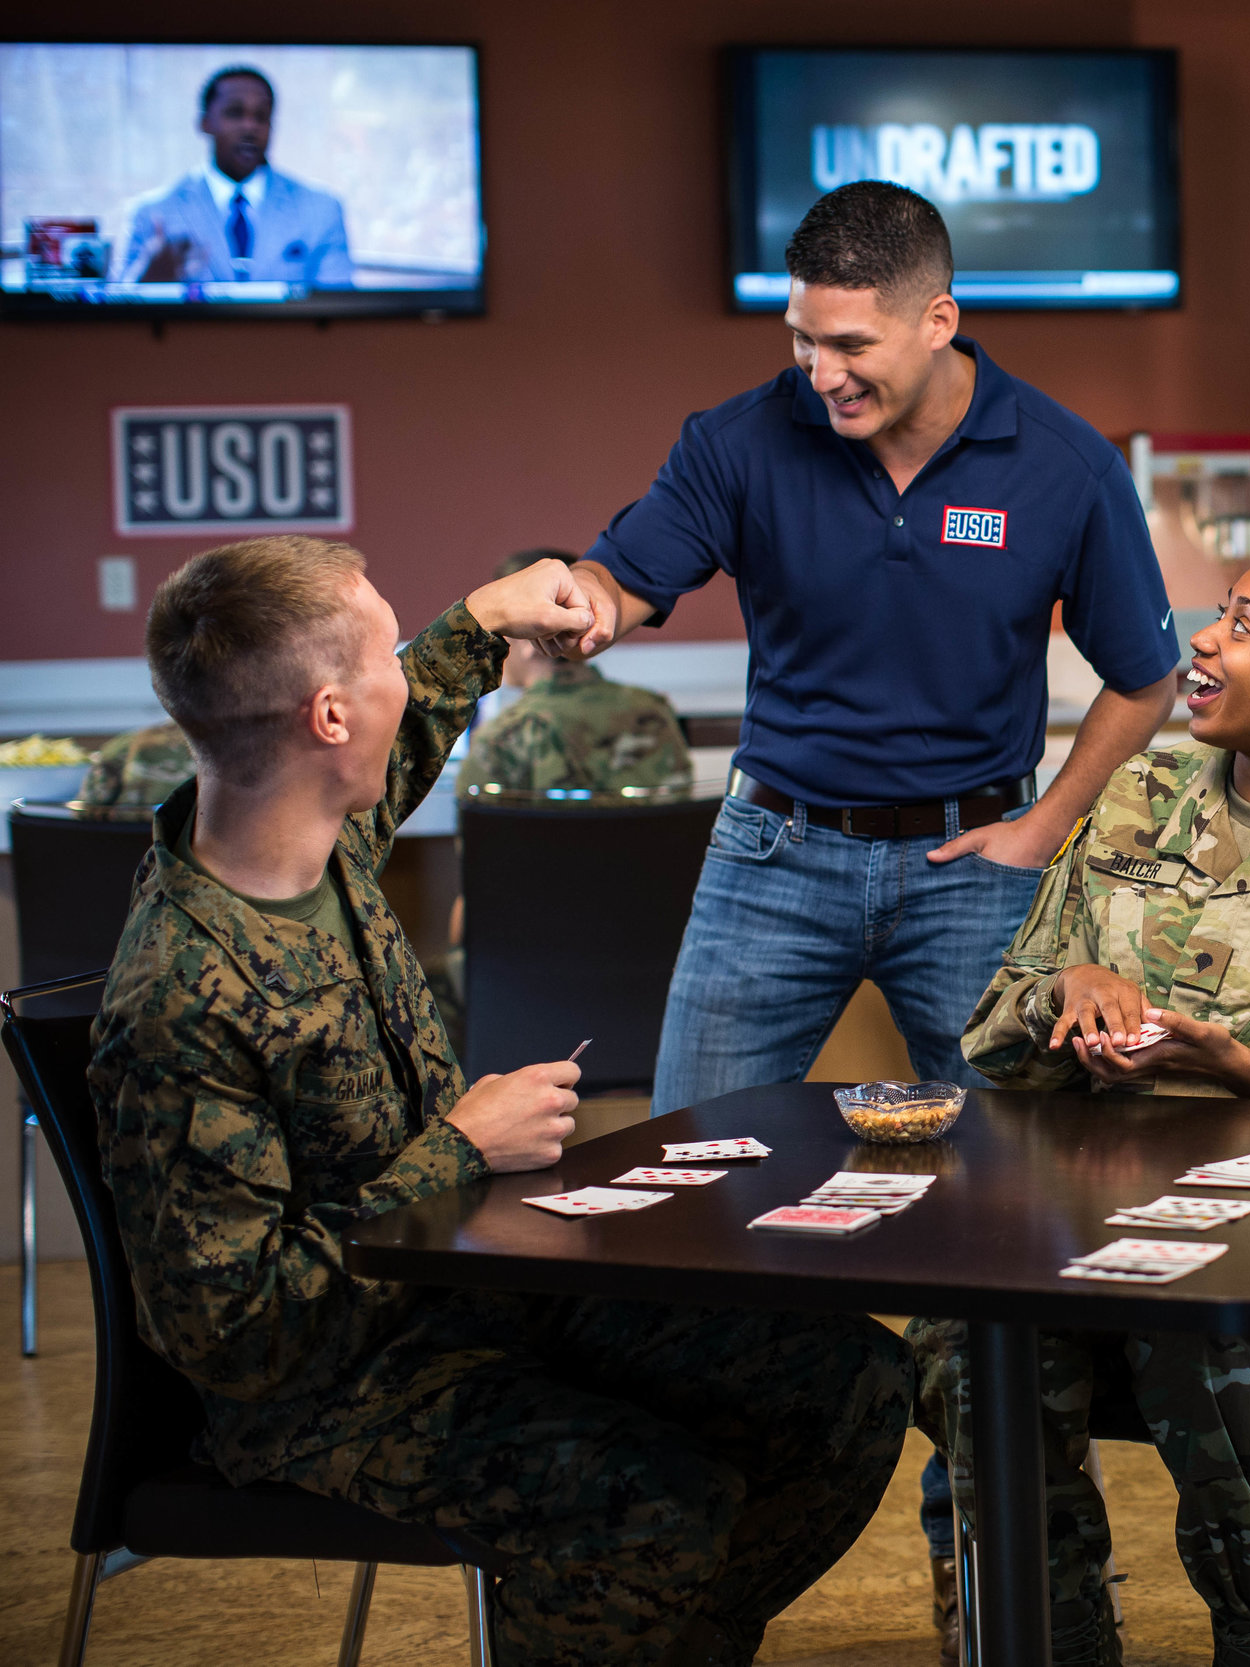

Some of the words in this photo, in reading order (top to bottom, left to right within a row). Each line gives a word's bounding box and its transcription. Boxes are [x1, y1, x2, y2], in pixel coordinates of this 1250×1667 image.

[811, 123, 1099, 199] UNDRAFTED
[161, 421, 304, 519] USO
[956, 513, 993, 541] USO
[336, 1069, 384, 1100] GRAHAM
